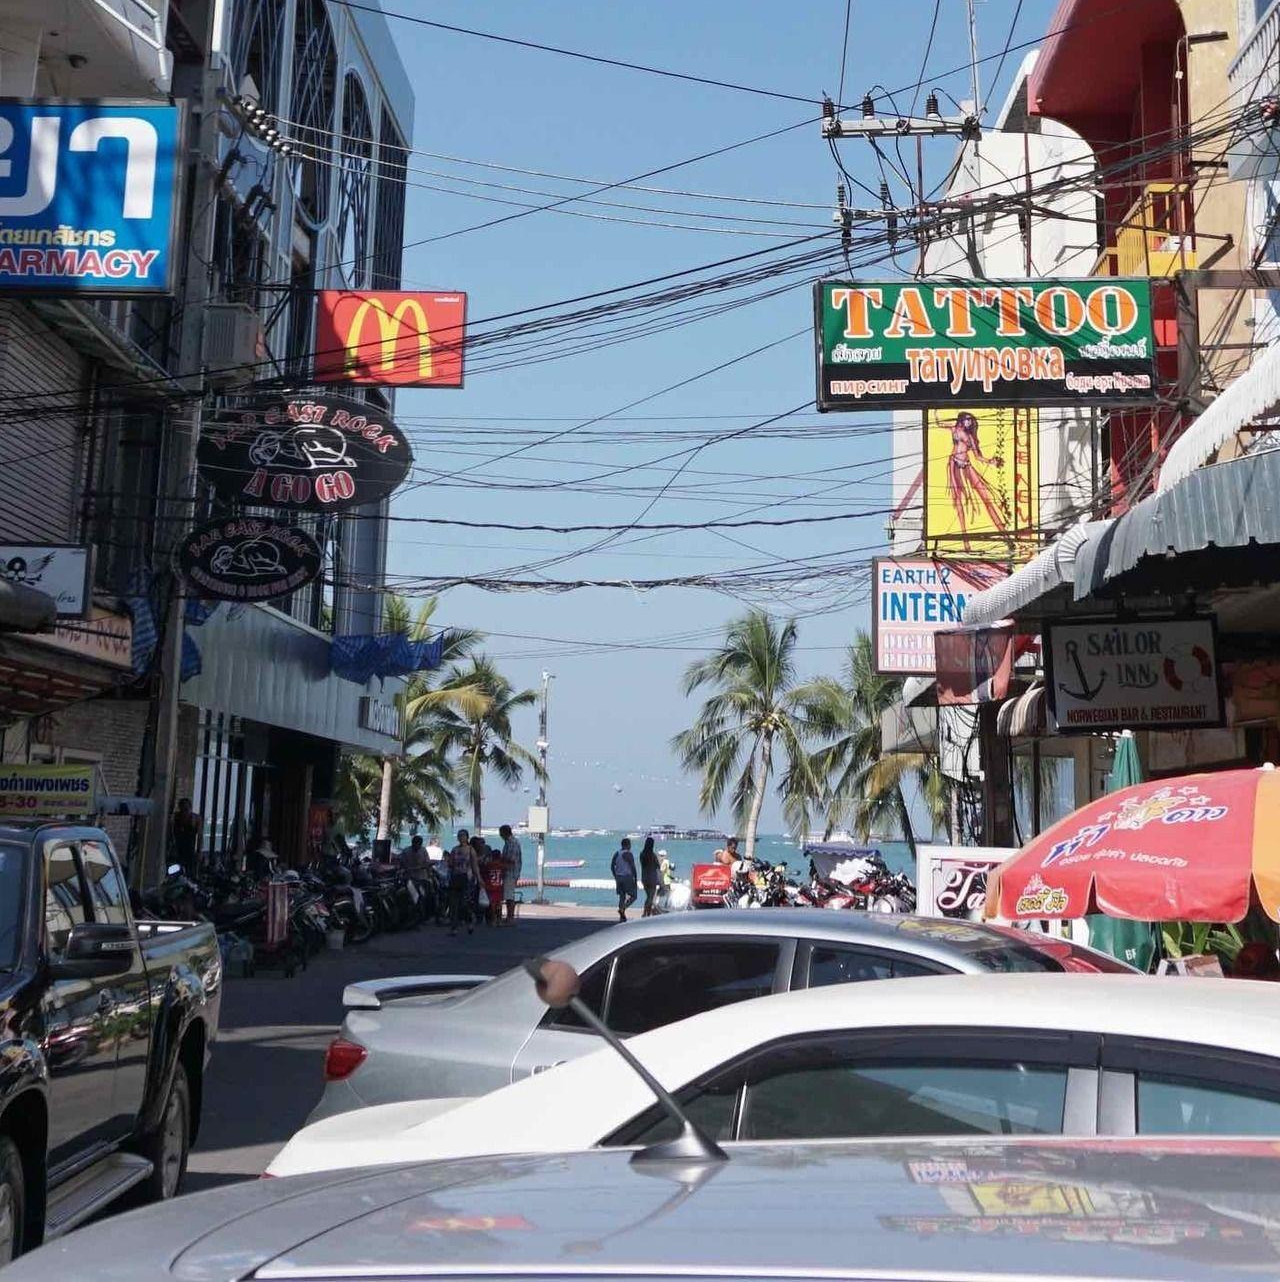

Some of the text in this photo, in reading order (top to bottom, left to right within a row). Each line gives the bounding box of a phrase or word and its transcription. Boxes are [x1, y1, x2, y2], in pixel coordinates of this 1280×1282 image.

[832, 286, 1139, 338] TATTOO
[831, 378, 909, 398] пирсинг
[905, 346, 1065, 395] татуировка
[330, 409, 400, 454] ROCK
[882, 569, 936, 585] EARTH
[1116, 663, 1158, 688] INN
